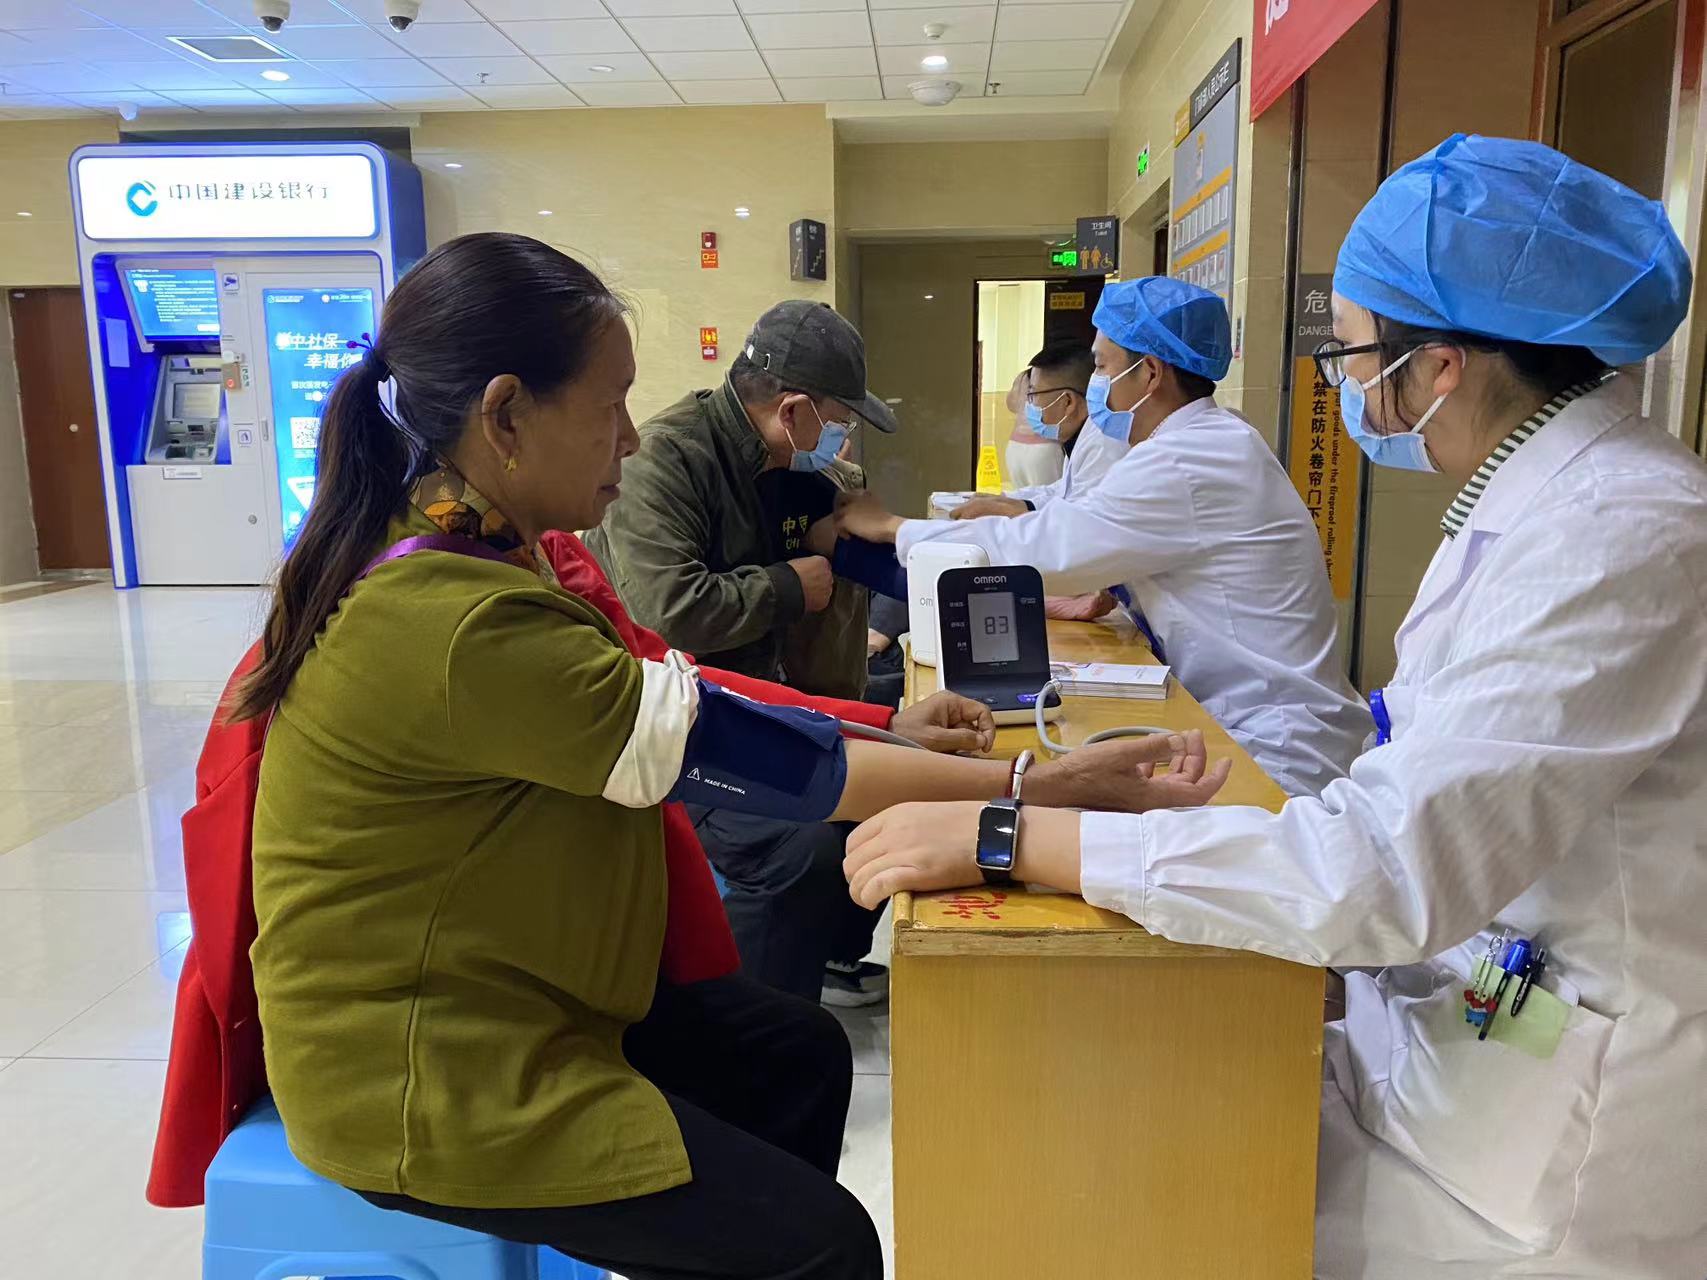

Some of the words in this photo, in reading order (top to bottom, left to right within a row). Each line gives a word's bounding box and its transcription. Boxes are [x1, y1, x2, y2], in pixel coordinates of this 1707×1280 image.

[168, 181, 328, 200] 中国建设银行
[1299, 325, 1334, 336] DANGE
[1308, 366, 1327, 534] 禁在防火卷帘门下
[1331, 439, 1340, 466] under
[1330, 468, 1338, 483] the
[1328, 486, 1338, 525] fireproof
[974, 575, 1007, 584] OMRON
[984, 615, 1009, 635] 83
[704, 778, 721, 787] MADE
[728, 785, 746, 795] CHINA
